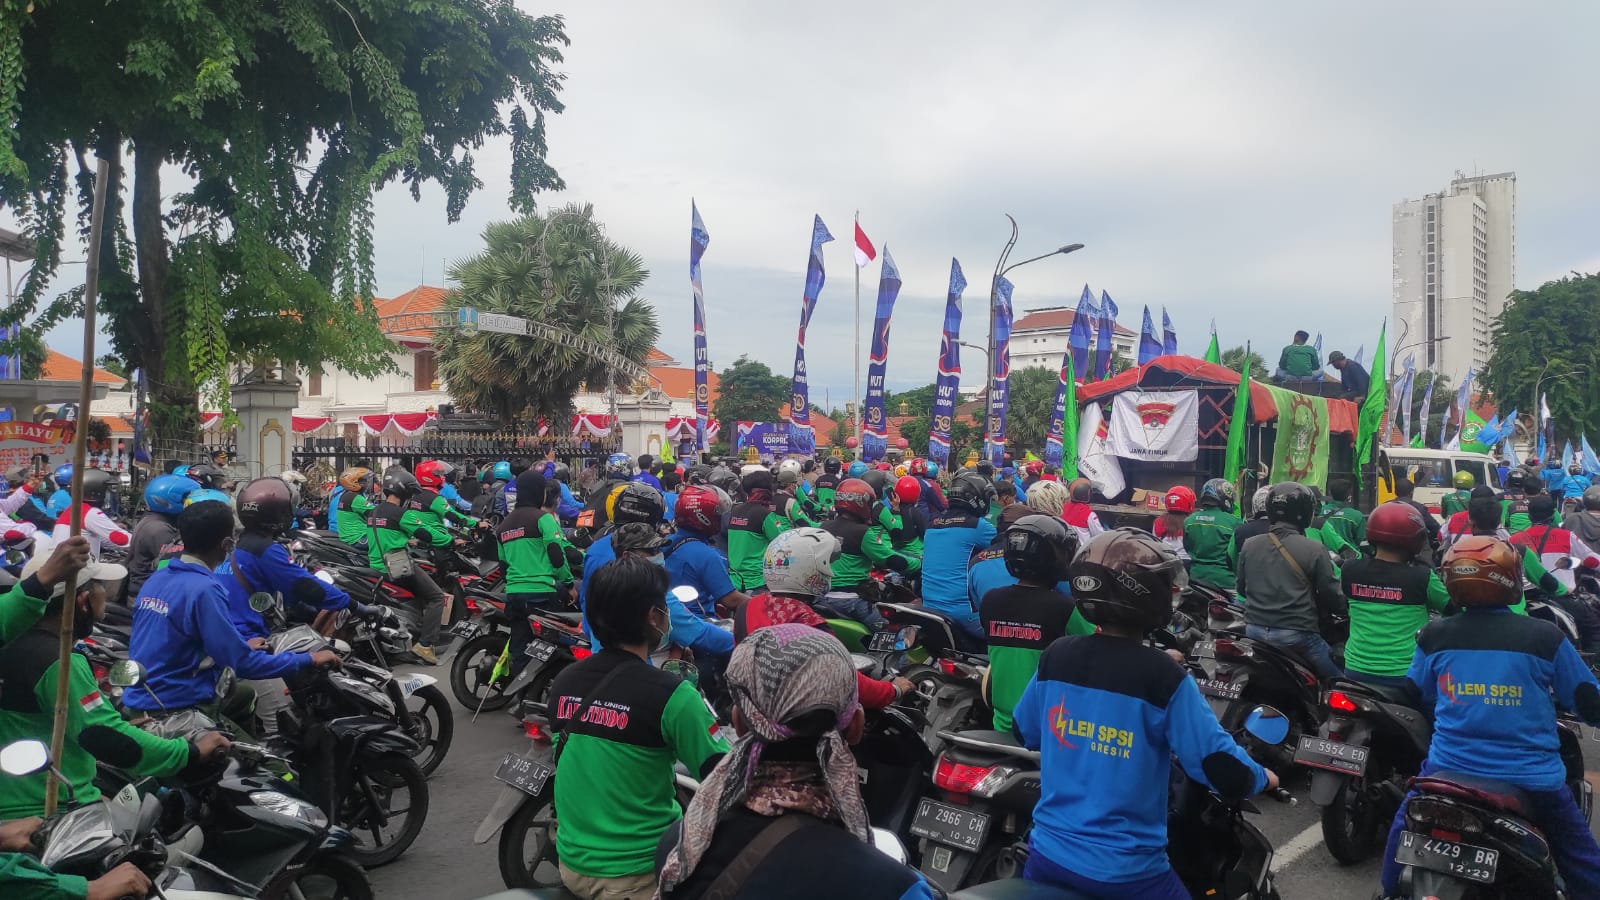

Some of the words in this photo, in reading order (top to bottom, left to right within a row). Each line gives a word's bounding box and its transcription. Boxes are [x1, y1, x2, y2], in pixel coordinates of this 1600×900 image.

[0, 425, 55, 440] AHAYU
[1129, 448, 1147, 456] JAWA
[1148, 448, 1168, 456] TIMUR
[1457, 682, 1487, 697] LEM
[1489, 684, 1524, 699] SPSI
[604, 701, 631, 712] UNION
[1484, 697, 1523, 708] GRESIK
[1097, 725, 1134, 749] SPSI
[1090, 741, 1131, 760] GRESIK
[1304, 739, 1313, 750] W
[1318, 741, 1346, 756] 5954
[1351, 749, 1366, 761] ED
[532, 767, 550, 781] LF
[921, 804, 931, 817] W
[935, 808, 962, 826] 2966
[968, 817, 984, 833] CH
[1403, 834, 1414, 848] W
[1423, 839, 1461, 858] 4429
[1474, 850, 1496, 866] BR
